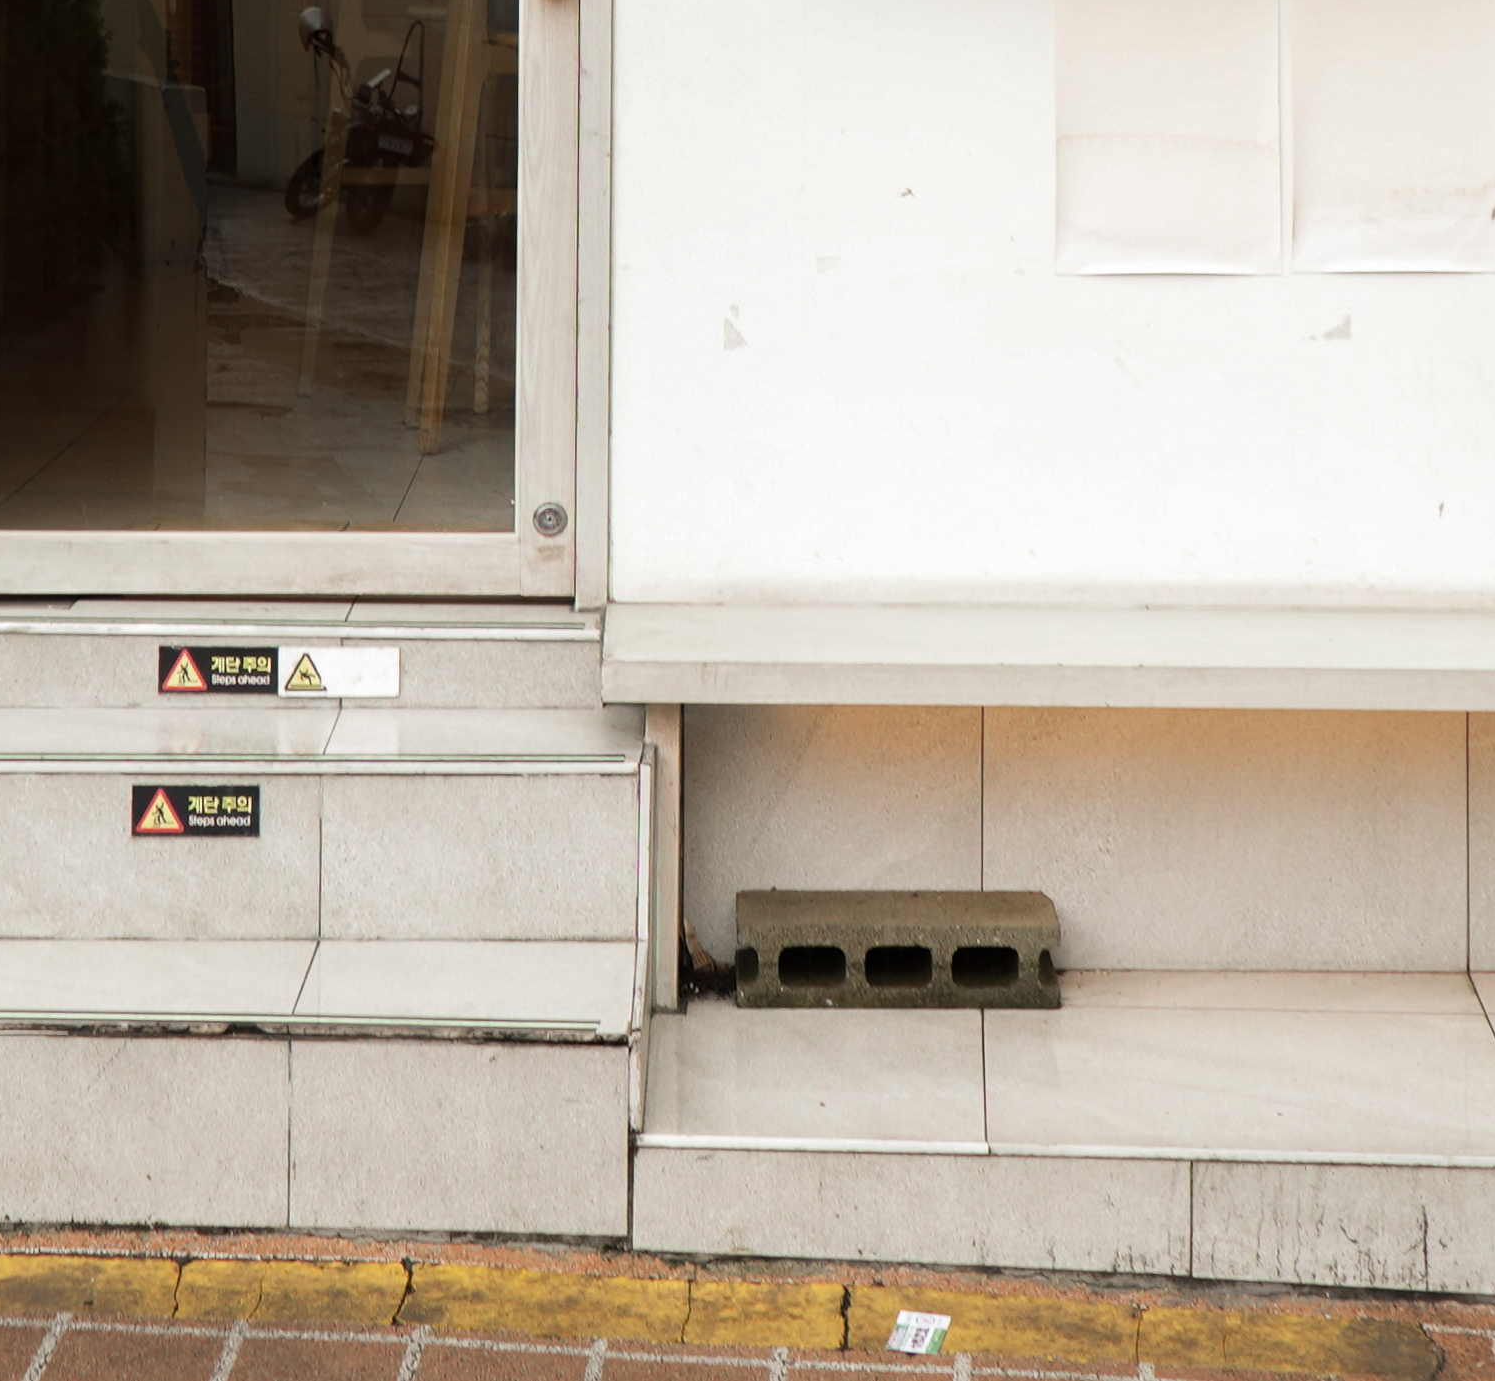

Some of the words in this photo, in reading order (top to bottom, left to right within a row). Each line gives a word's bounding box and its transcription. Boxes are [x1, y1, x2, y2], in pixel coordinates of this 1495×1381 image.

[211, 656, 241, 673] 계단
[242, 656, 272, 673] 주의
[211, 673, 237, 686] Steps
[237, 674, 271, 686] ahead
[188, 795, 220, 814] 계단
[221, 795, 252, 814] 주의
[188, 814, 215, 828] Steps
[216, 814, 251, 827] ahead
